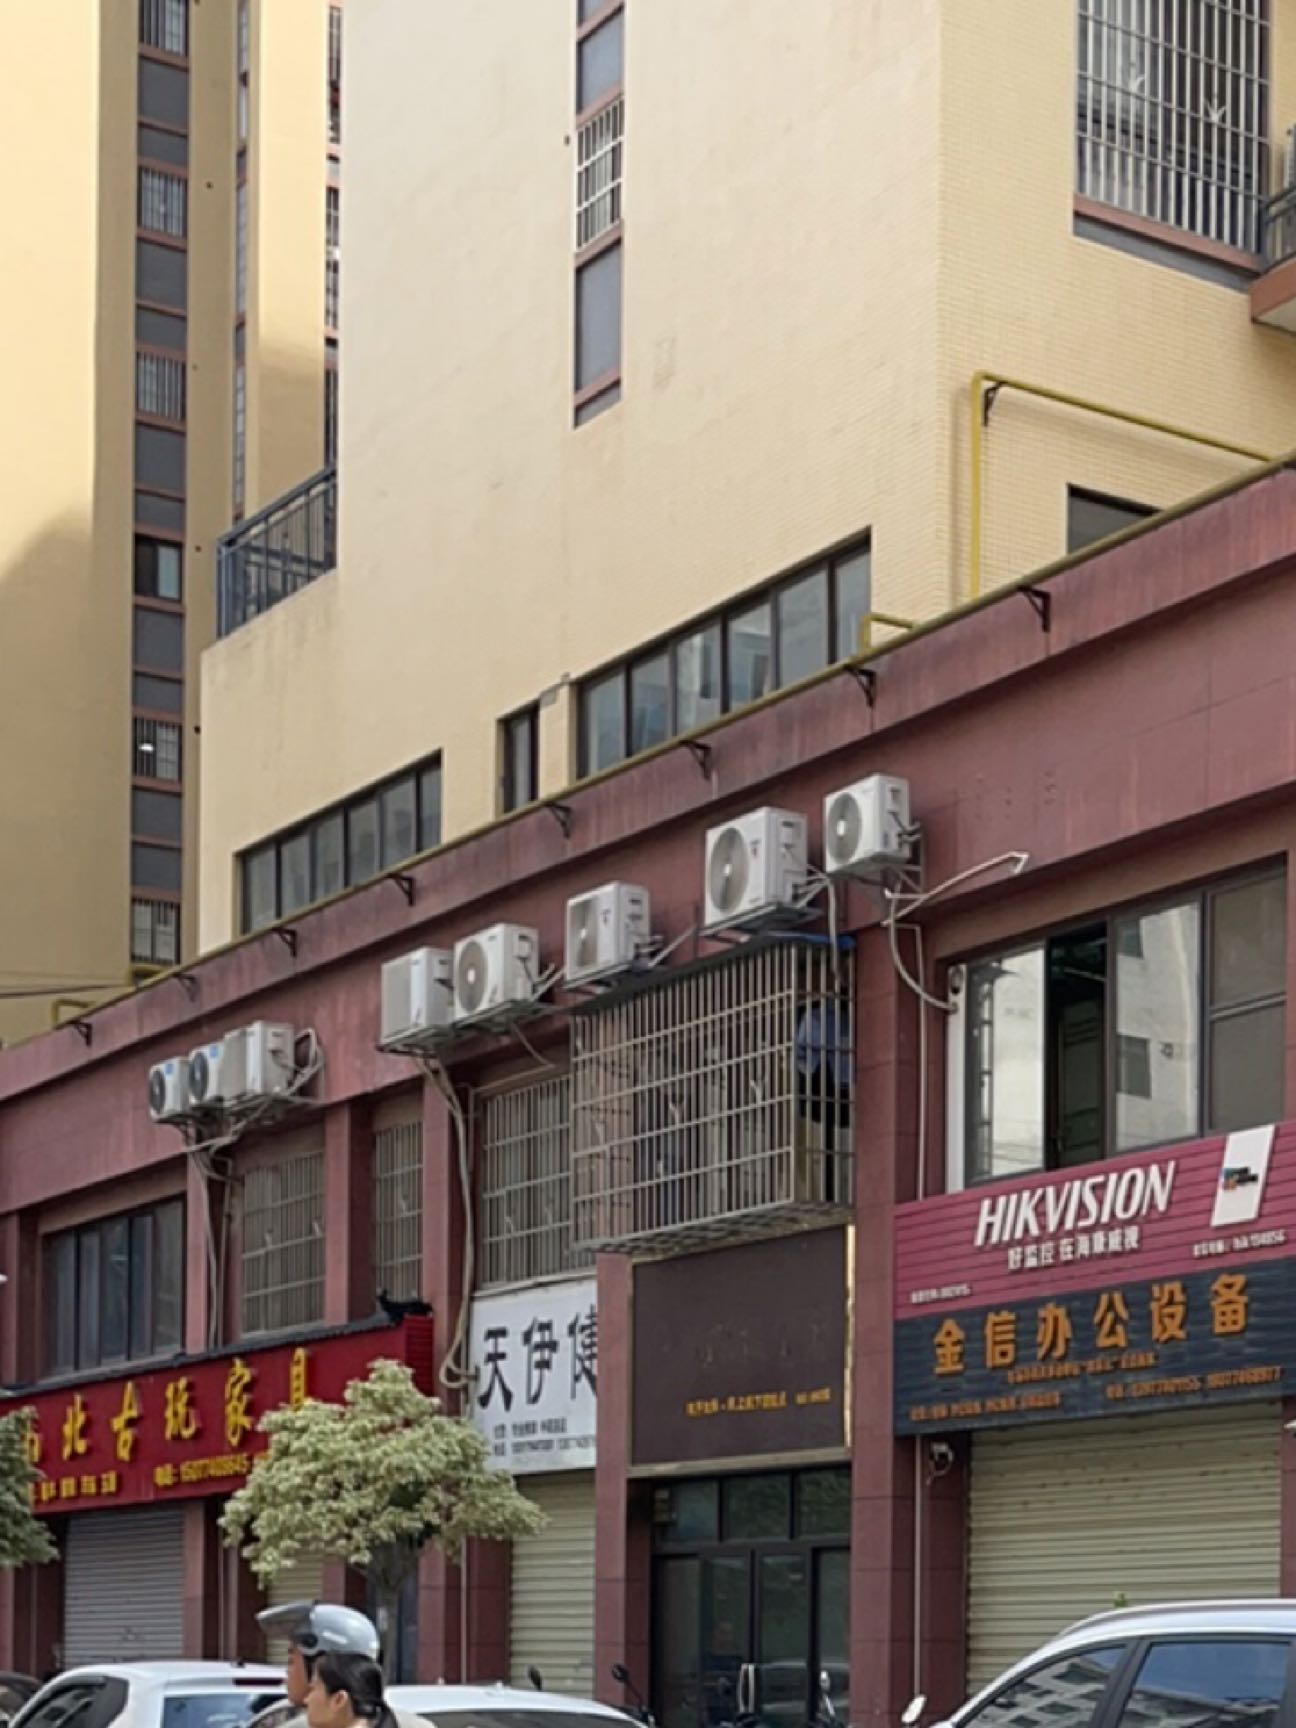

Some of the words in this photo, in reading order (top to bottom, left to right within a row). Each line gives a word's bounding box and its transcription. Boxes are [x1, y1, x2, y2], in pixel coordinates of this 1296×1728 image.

[974, 1159, 1176, 1247] HIKVISION
[478, 1303, 597, 1411] 天伊健
[933, 1273, 1249, 1375] 金信办公设备
